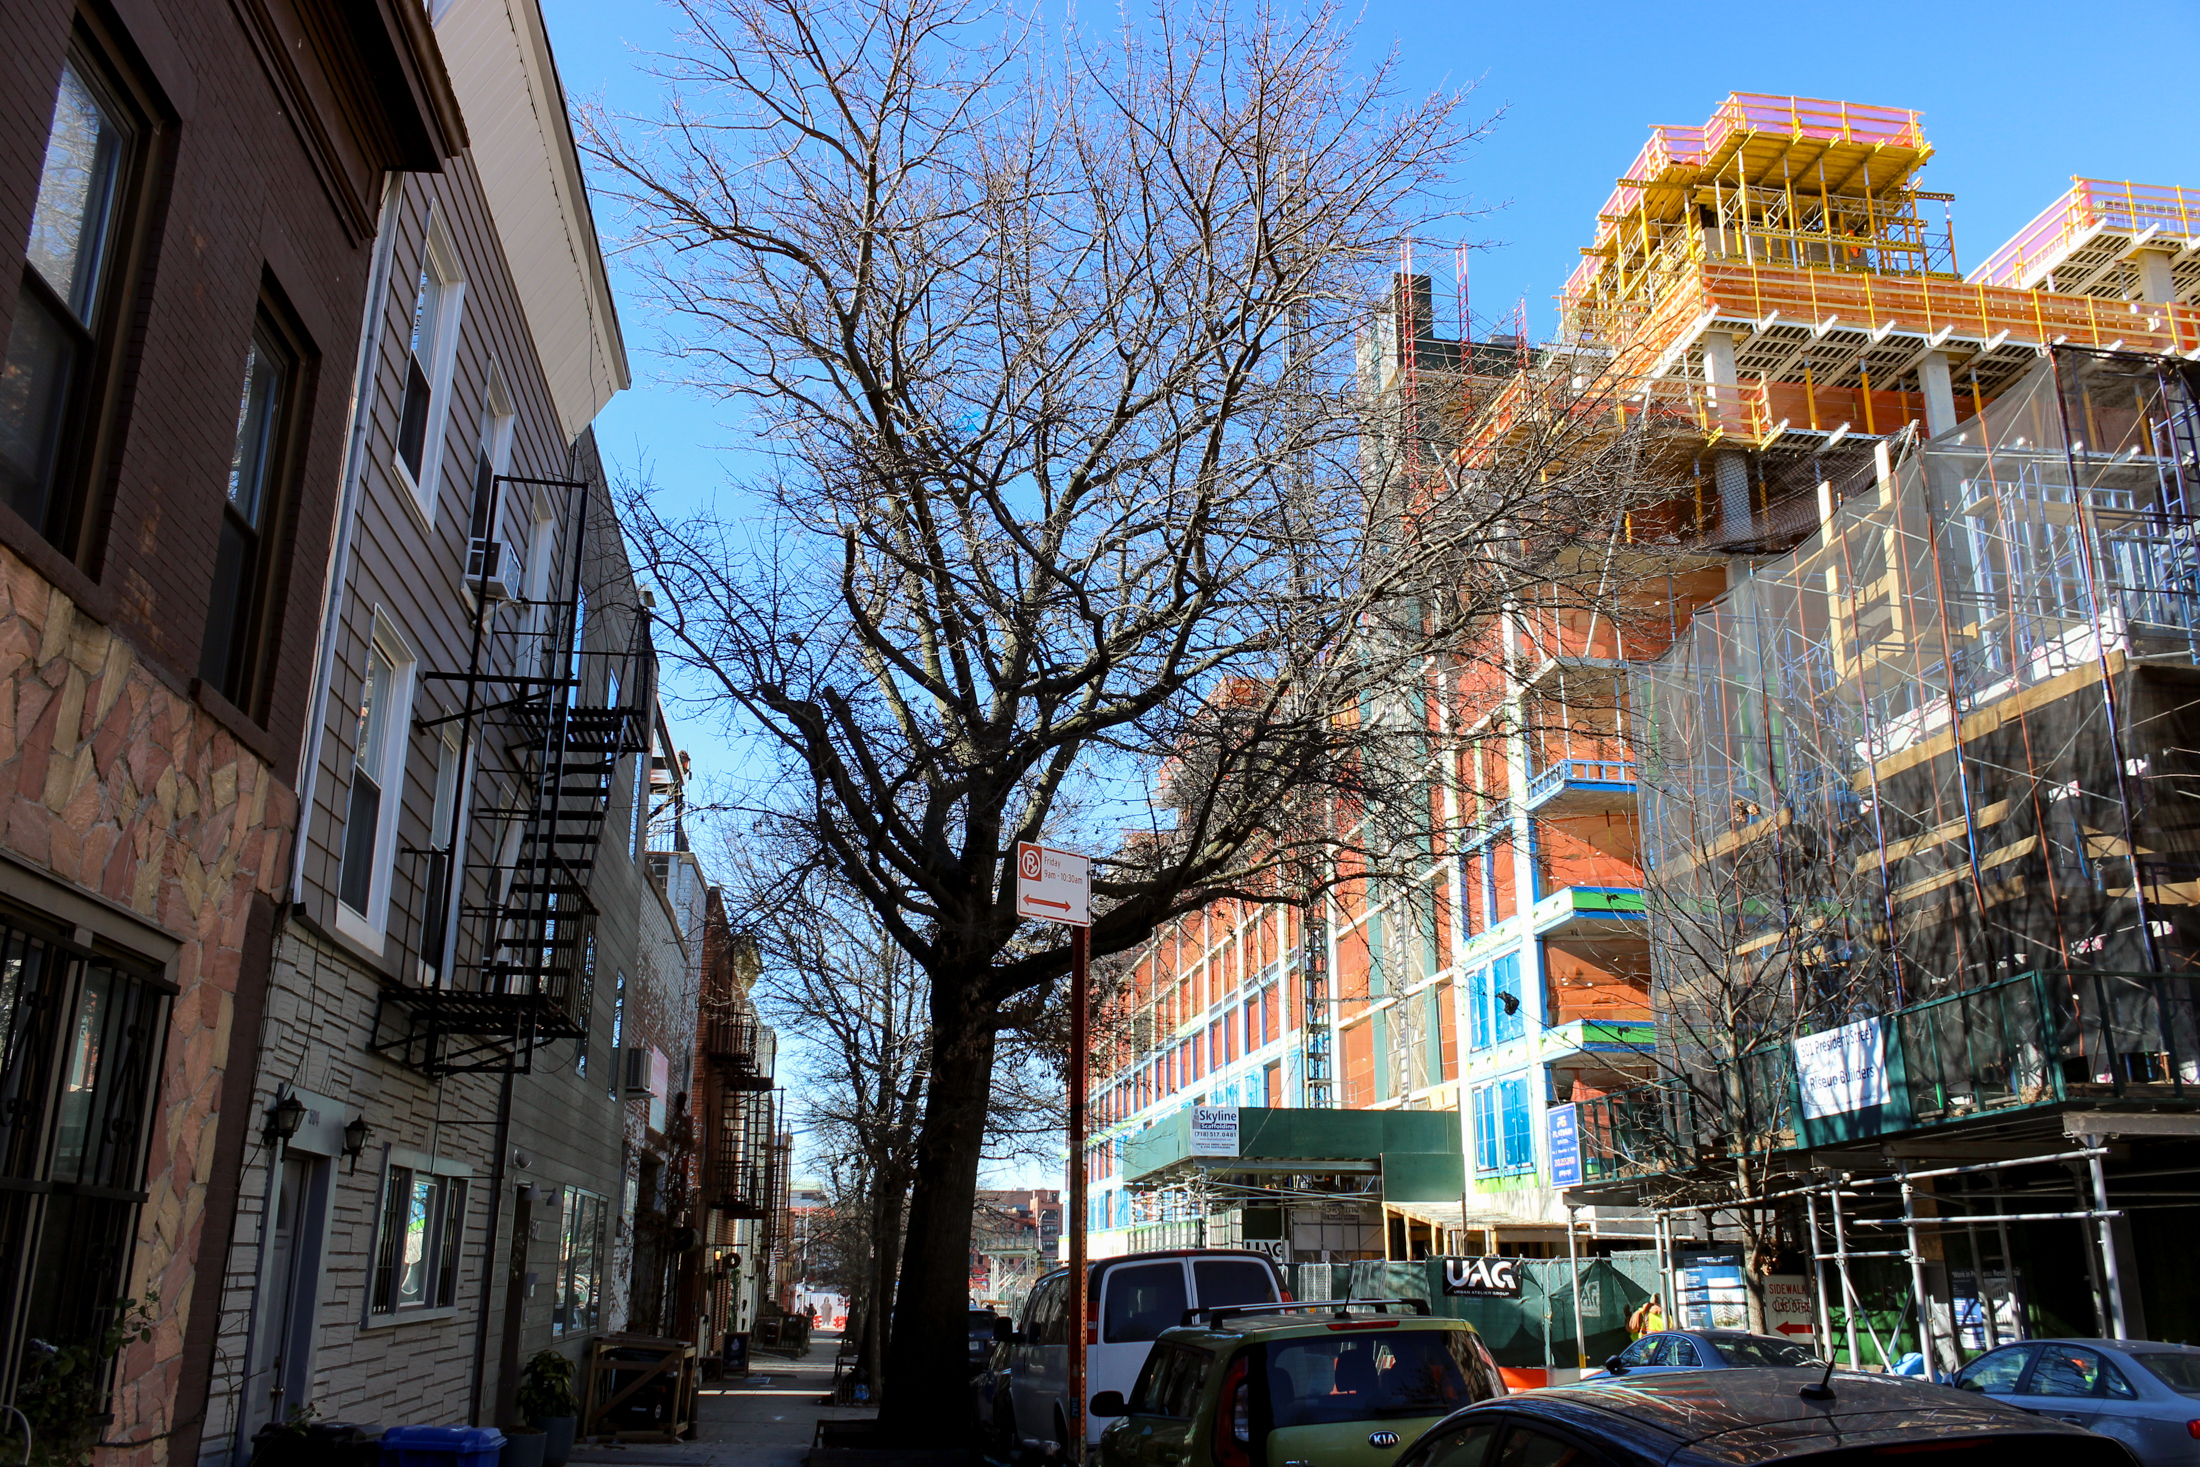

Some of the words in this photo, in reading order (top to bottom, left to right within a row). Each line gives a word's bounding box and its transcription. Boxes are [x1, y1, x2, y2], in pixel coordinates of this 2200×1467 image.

[1044, 856, 1061, 869] Friday
[1044, 869, 1056, 880] 9am
[1060, 872, 1083, 885] 10:30am
[1815, 1034, 1850, 1055] President
[1850, 1026, 1874, 1044] Street
[1809, 1073, 1838, 1091] Riseup
[1840, 1066, 1874, 1084] Builders
[1199, 1109, 1237, 1124] Skyline
[1446, 1259, 1517, 1290] UAG
[1769, 1283, 1807, 1295] SIDEWALK
[1791, 1301, 1811, 1313] OTHE
[1071, 1397, 1079, 1418] SHAZ
[1373, 1434, 1396, 1446] KIA
